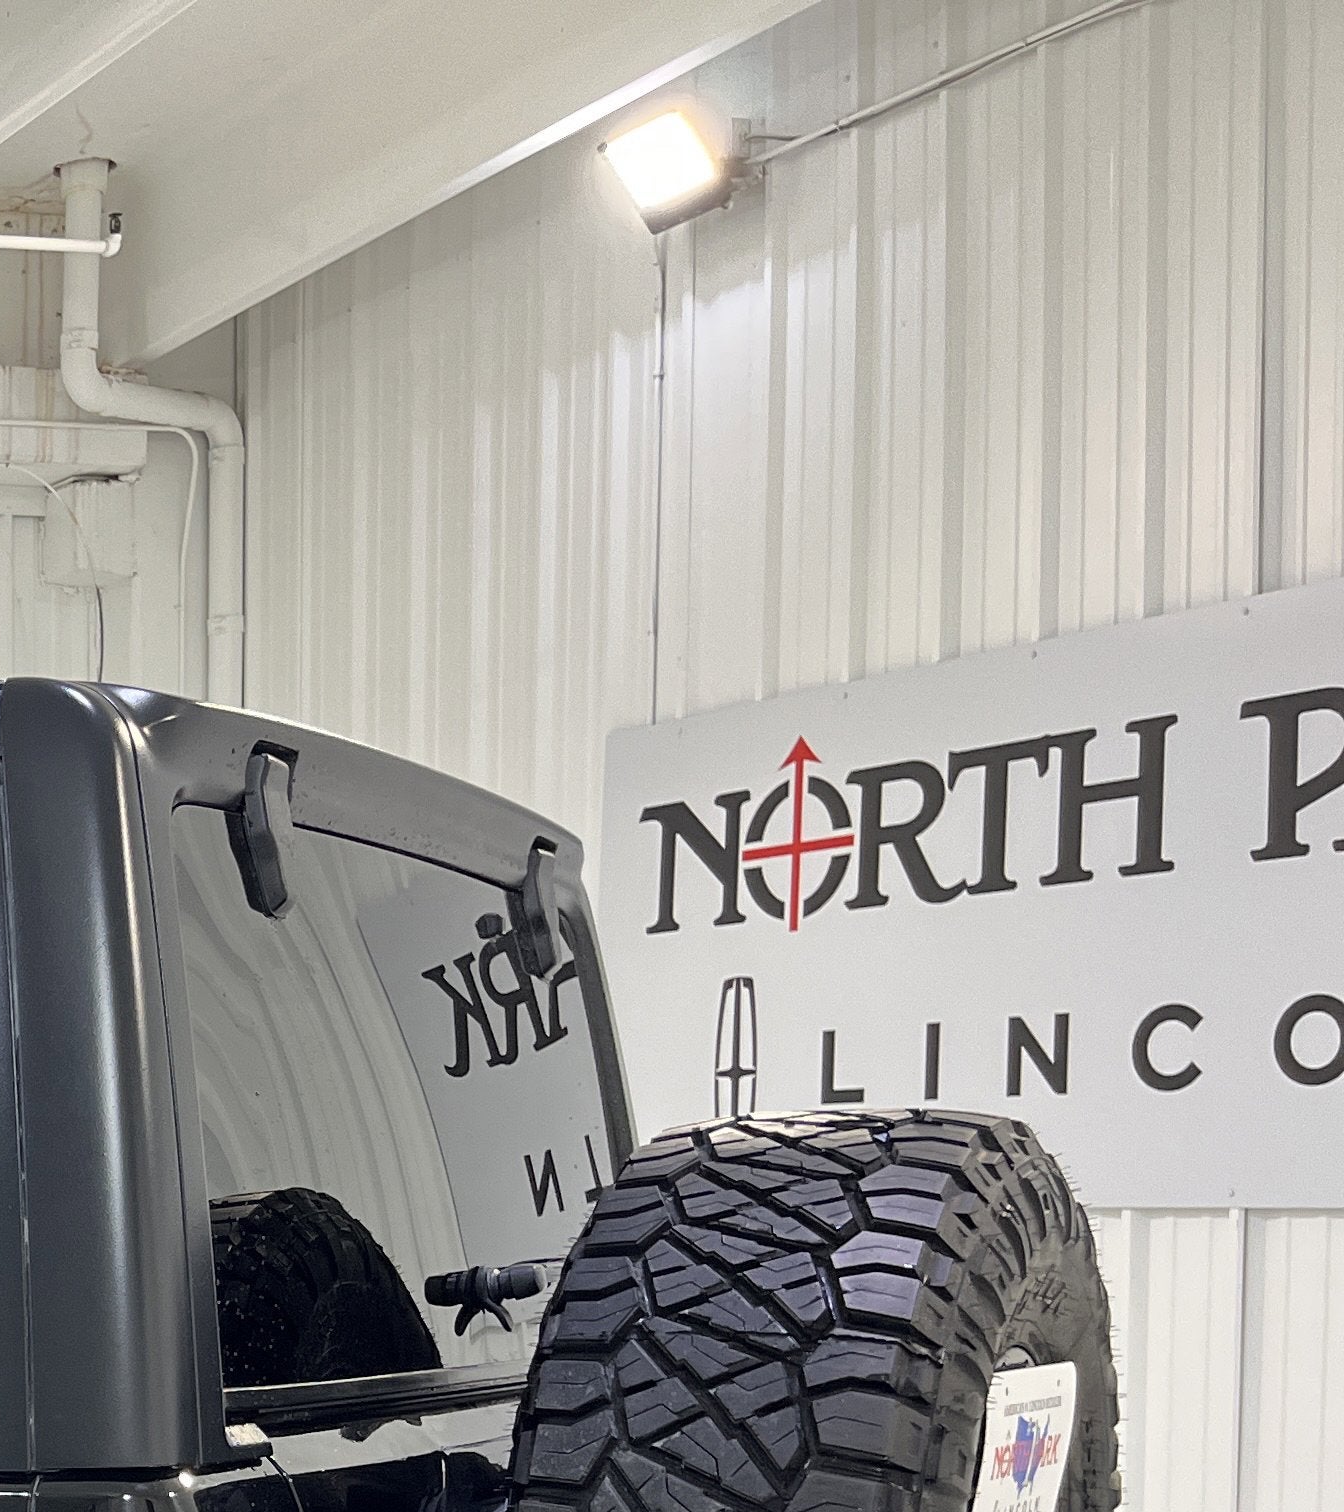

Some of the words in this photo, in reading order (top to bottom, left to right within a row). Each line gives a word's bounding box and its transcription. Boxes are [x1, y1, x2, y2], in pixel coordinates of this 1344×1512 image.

[639, 713, 1179, 935] NORTH
[1239, 686, 1344, 862] P
[820, 993, 1344, 1104] LINCO
